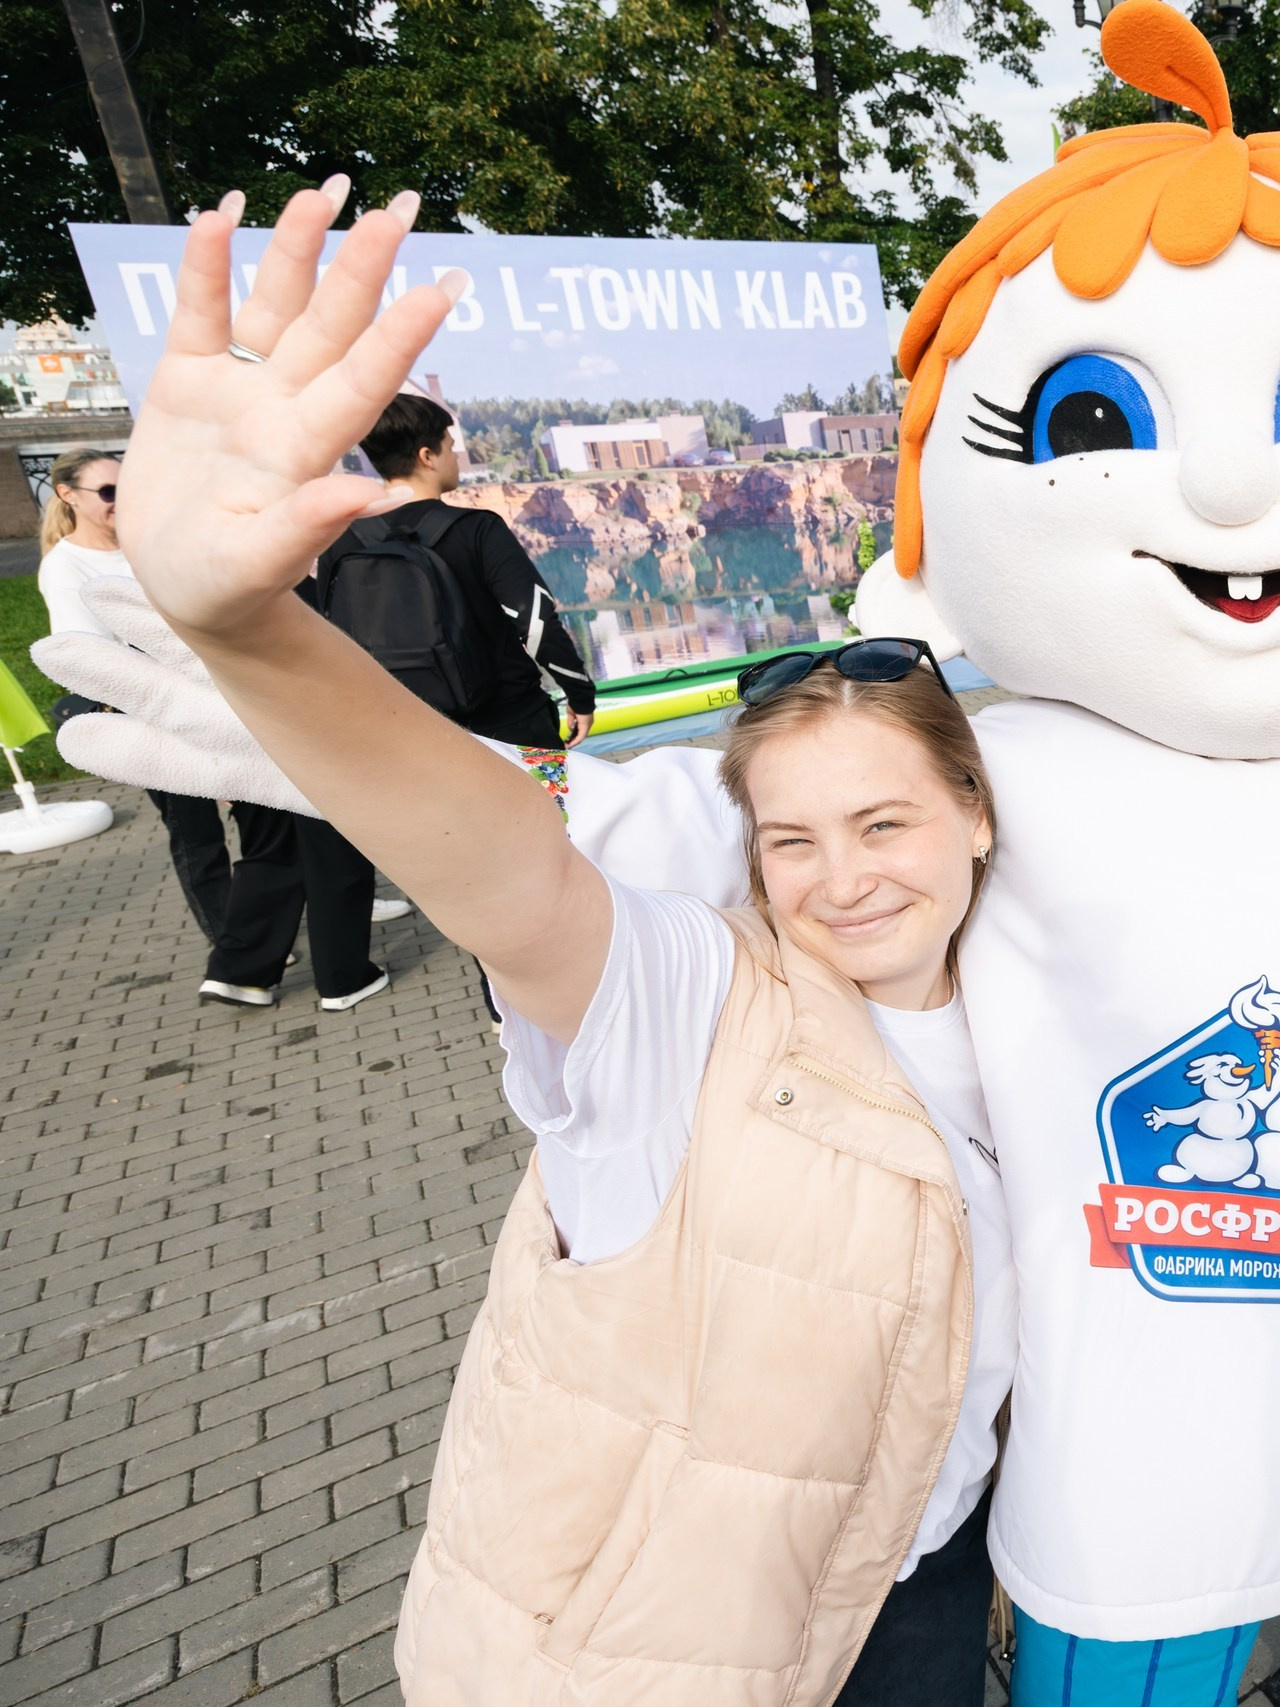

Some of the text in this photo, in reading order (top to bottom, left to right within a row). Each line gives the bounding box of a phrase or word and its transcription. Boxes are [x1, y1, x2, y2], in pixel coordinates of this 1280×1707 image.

[499, 266, 722, 331] L-TOWN
[734, 269, 868, 330] KLAB
[706, 688, 738, 706] L-TO
[1153, 1254, 1226, 1277] ФАБРИКА
